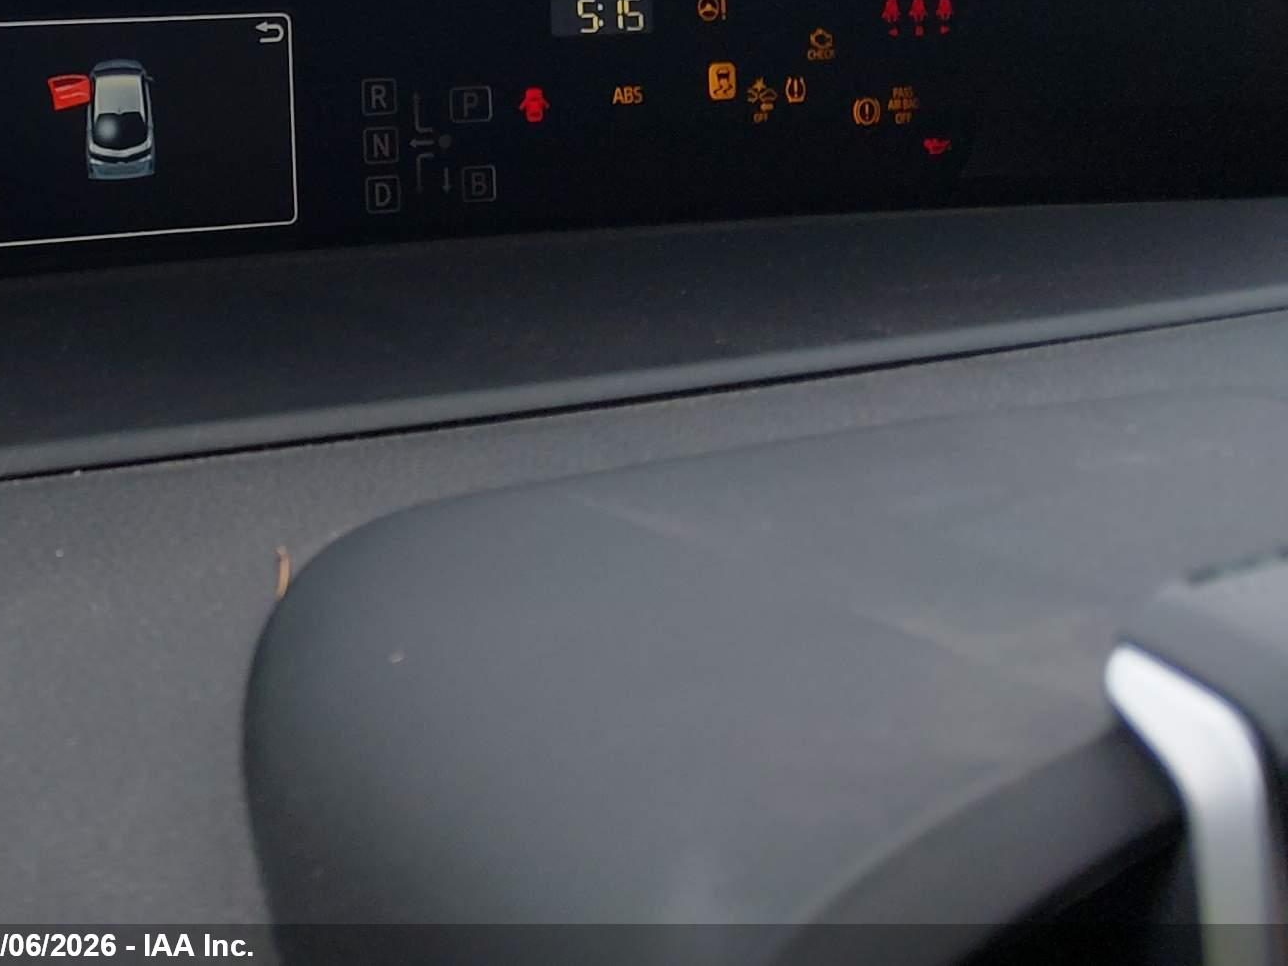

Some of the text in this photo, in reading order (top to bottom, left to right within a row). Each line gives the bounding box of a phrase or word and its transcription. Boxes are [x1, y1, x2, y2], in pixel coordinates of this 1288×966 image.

[807, 49, 835, 61] CHECK
[370, 84, 387, 109] R
[463, 92, 479, 117] P
[612, 86, 642, 104] ABS
[895, 113, 912, 124] OFF
[373, 133, 390, 158] N
[374, 182, 392, 207] D
[471, 171, 487, 196] B
